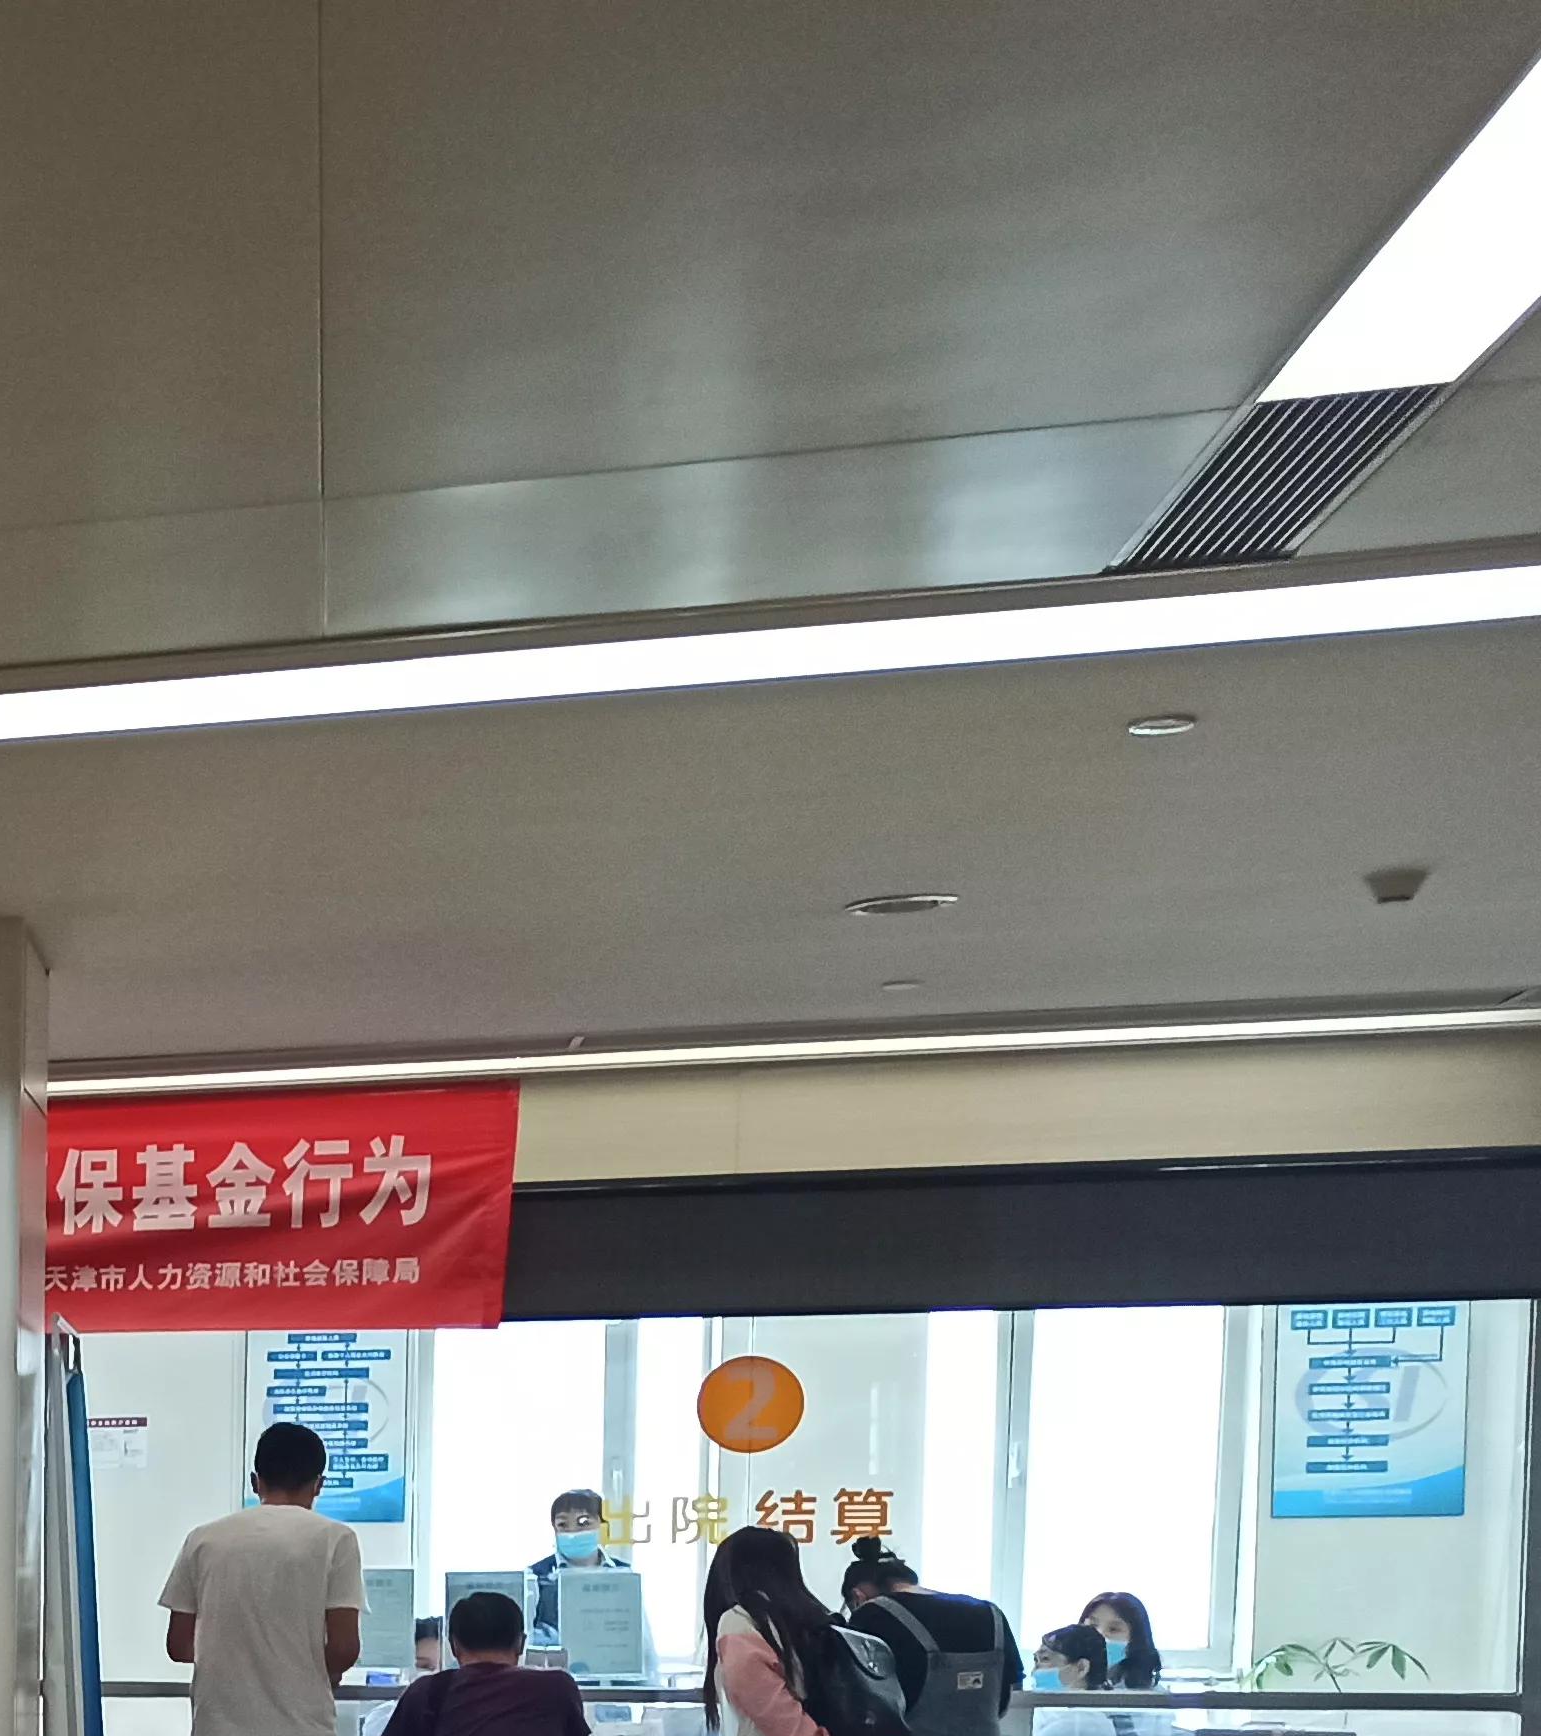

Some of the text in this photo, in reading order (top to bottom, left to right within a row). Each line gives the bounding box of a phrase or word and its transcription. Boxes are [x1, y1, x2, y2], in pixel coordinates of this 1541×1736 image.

[55, 1135, 432, 1235] 保基金行为
[44, 1256, 420, 1292] 天津市人力资源和社会保障局
[723, 1364, 779, 1441] 2
